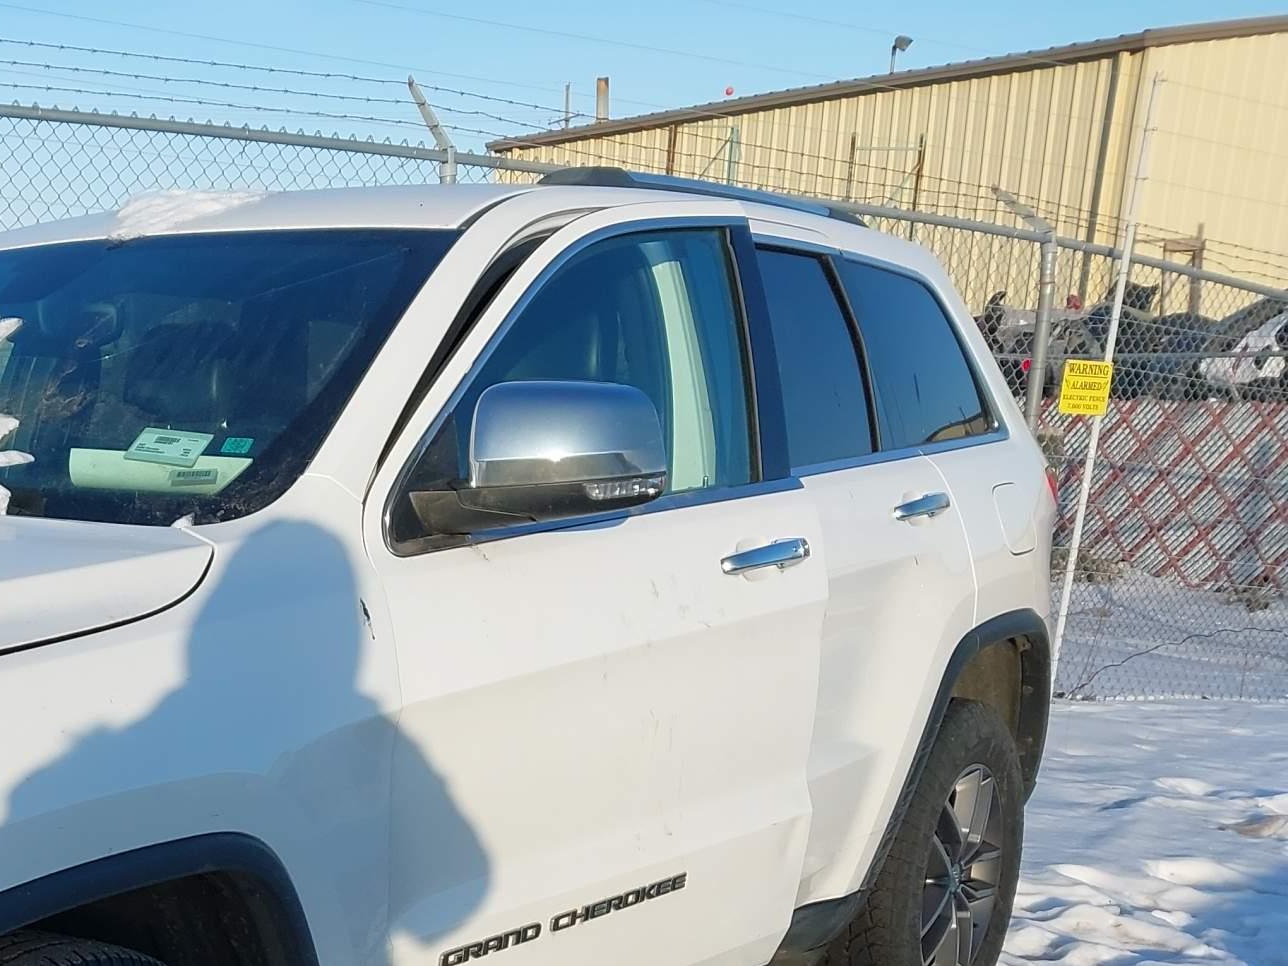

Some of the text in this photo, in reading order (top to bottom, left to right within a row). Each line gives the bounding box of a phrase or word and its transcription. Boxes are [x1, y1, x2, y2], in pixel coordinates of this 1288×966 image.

[1069, 363, 1110, 376] WARNING
[1071, 380, 1103, 391] ALARMED
[550, 872, 688, 932] CHEROKEE
